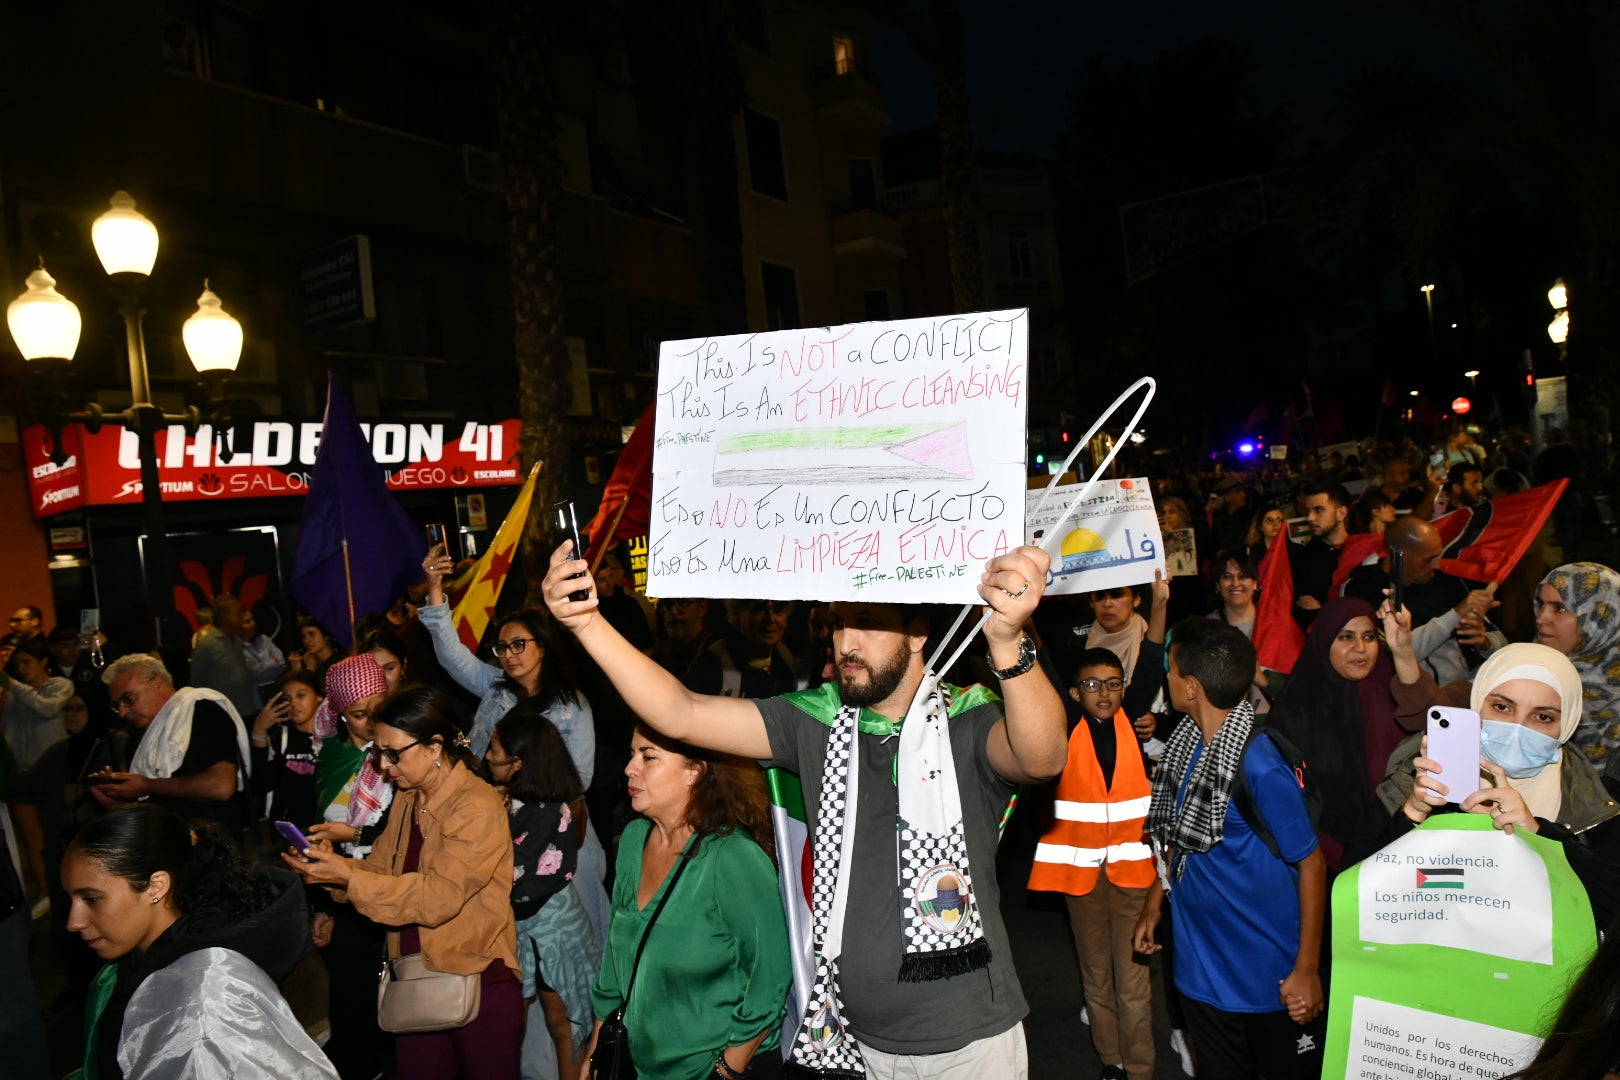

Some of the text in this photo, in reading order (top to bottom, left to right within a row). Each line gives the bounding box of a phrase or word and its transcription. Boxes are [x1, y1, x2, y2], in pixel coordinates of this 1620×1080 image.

[677, 312, 1024, 387] This Is NOT a CONFLICT
[658, 377, 710, 418] This
[714, 382, 749, 420] Is
[756, 386, 783, 420] An
[790, 377, 896, 422] ETHNIC
[460, 422, 503, 461] 41
[656, 481, 1004, 529] Eso NO Es Un CONFLICTO
[719, 539, 771, 574] Una
[1375, 853, 1499, 868] Paz, no violencia.
[1375, 891, 1511, 910] Los niños merecen
[1375, 909, 1448, 923] seguridad.
[1364, 1037, 1412, 1058] humanos.
[1416, 1050, 1428, 1061] Es
[1430, 1053, 1456, 1069] hora
[1459, 1062, 1473, 1074] de
[1476, 1068, 1499, 1080] que
[1366, 1022, 1514, 1067] Unidos por los derechos
[1362, 1054, 1414, 1075] conciencia
